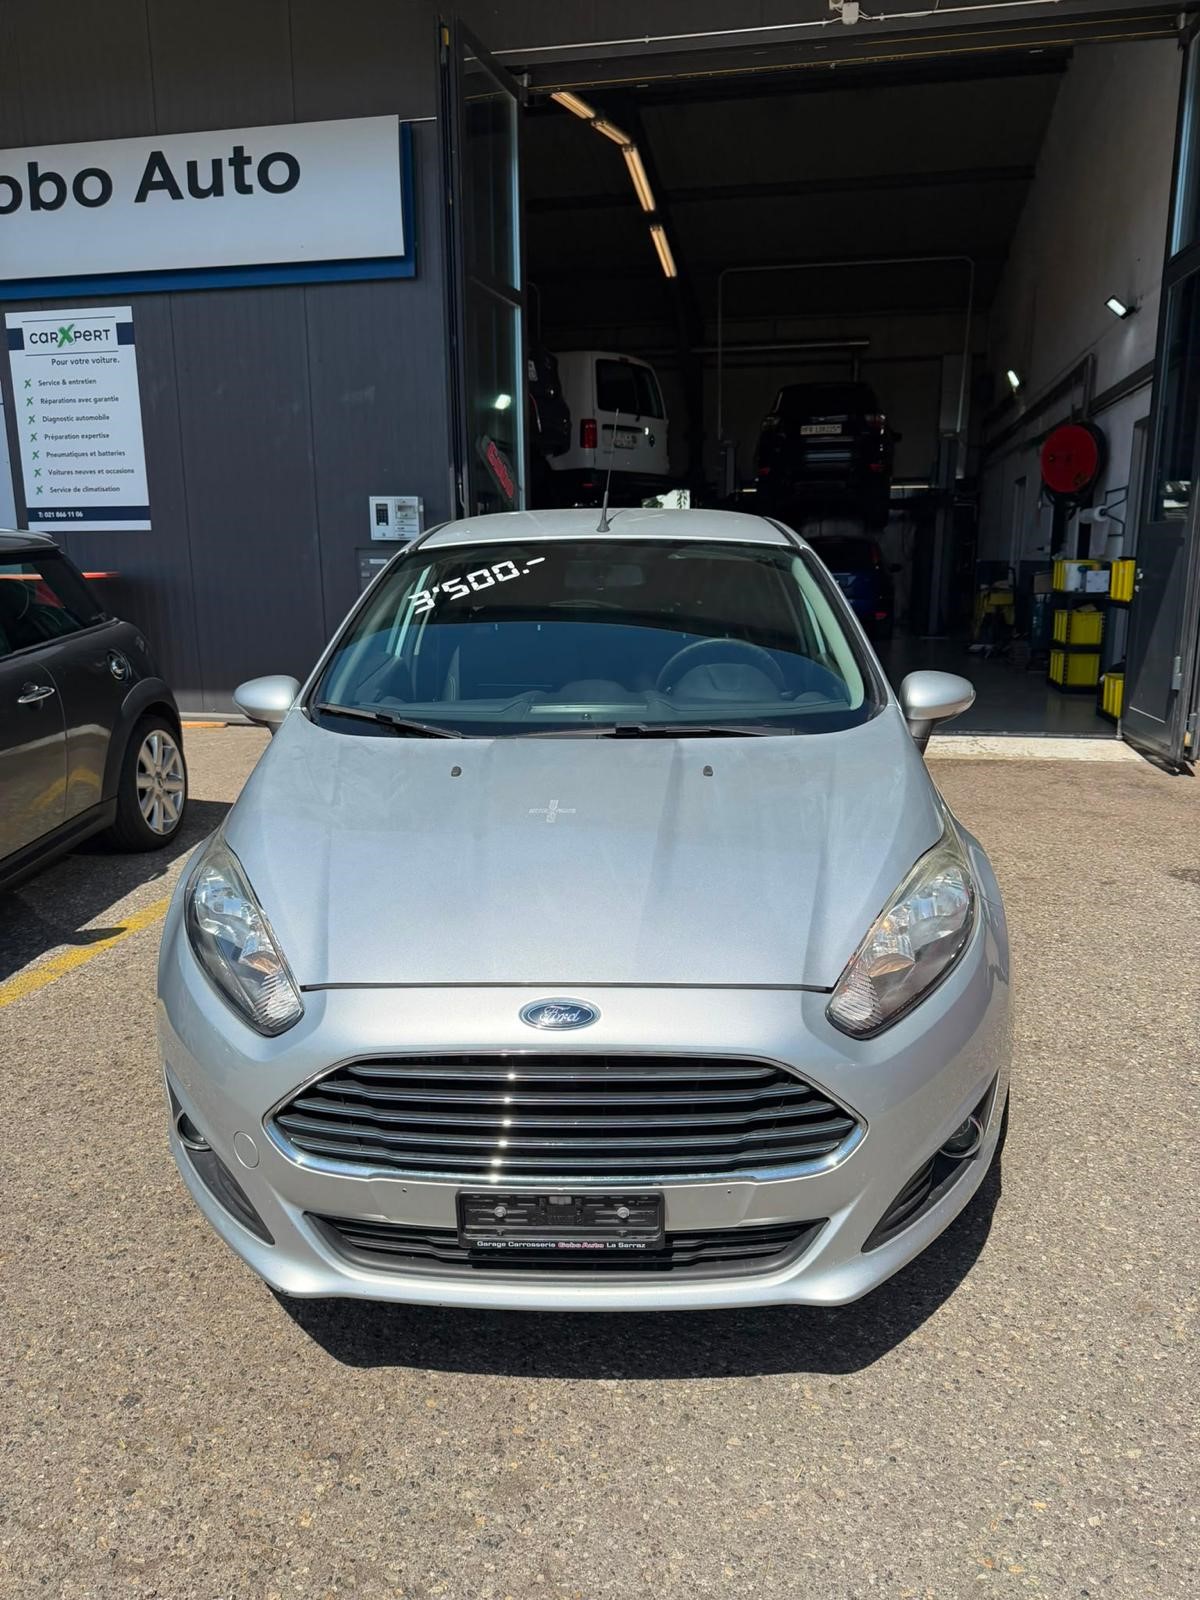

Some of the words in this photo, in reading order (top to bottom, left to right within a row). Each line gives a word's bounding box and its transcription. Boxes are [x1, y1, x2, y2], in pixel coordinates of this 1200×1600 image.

[134, 145, 301, 203] Auto
[92, 356, 120, 364] voiture.
[40, 397, 76, 405] Réparations
[93, 395, 119, 404] garantie
[42, 415, 74, 424] Diagnostic
[44, 433, 79, 441] Préparation
[81, 432, 110, 440] expertise
[540, 1005, 581, 1023] Ford
[477, 1240, 506, 1249] Garage
